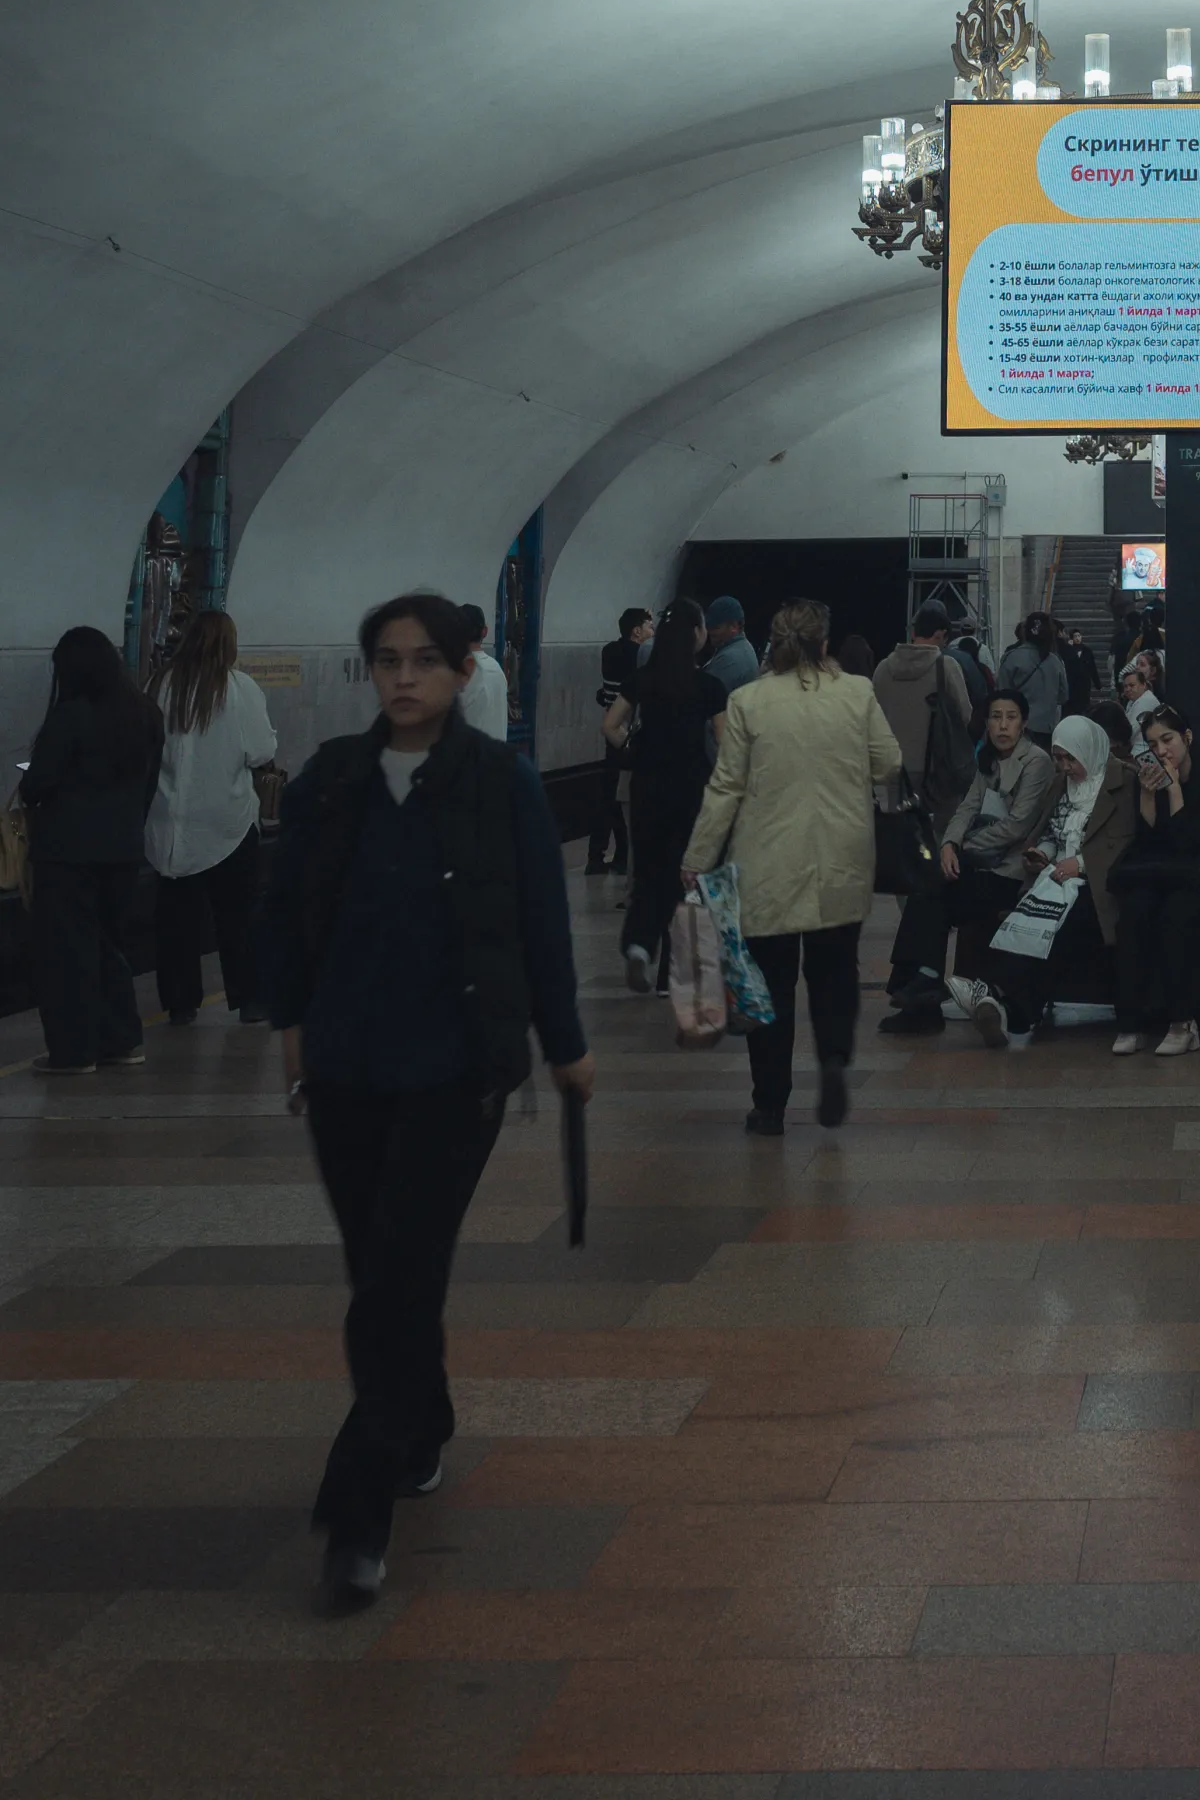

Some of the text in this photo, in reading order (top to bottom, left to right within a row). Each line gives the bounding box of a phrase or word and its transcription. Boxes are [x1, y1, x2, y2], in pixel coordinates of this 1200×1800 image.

[1064, 135, 1172, 158] Скрининг
[1070, 163, 1135, 188] бепул
[1139, 163, 1199, 187] ўтиш
[999, 260, 1022, 271] 2-10
[1023, 260, 1056, 271] ёшли
[1058, 260, 1102, 273] болалар
[1104, 261, 1176, 270] гельминтозга
[999, 276, 1022, 287] 3-18
[1023, 275, 1056, 286] ёшли
[1057, 275, 1103, 289] болалар
[1104, 277, 1196, 286] онкогематологик
[998, 291, 1012, 302] 40
[1013, 293, 1028, 302] ва
[1030, 292, 1065, 304] ундан
[1067, 292, 1099, 302] катта
[1101, 291, 1141, 303] ёшдаги
[999, 308, 1066, 319] омилларини
[1067, 308, 1116, 318] аниқлаш
[1118, 306, 1124, 317] 1
[1126, 305, 1164, 318] йилда
[1166, 306, 1172, 316] 1
[998, 322, 1028, 333] 35-55
[1029, 321, 1062, 333] ёшли
[1063, 323, 1102, 334] аёллар
[1103, 321, 1148, 333] бачадон
[1150, 321, 1183, 334] бўйни
[1001, 337, 1030, 348] 45-65
[1031, 337, 1064, 348] ёшли
[1066, 337, 1104, 350] аёллар
[1106, 336, 1142, 350] кўкрак
[1143, 336, 1168, 347] бези
[999, 353, 1028, 363] 15-49
[1028, 352, 1061, 363] ёшли
[1063, 354, 1135, 365] хотин-қизлар
[1000, 367, 1095, 381] 1 йилда 1 марта;
[998, 384, 1019, 394] Сил
[1020, 385, 1075, 395] касаллиги
[1076, 383, 1115, 396] бўйича
[1117, 383, 1144, 396] хавф
[1146, 383, 1152, 393] 1
[1154, 382, 1191, 395] йилда
[1194, 383, 1200, 393] 1
